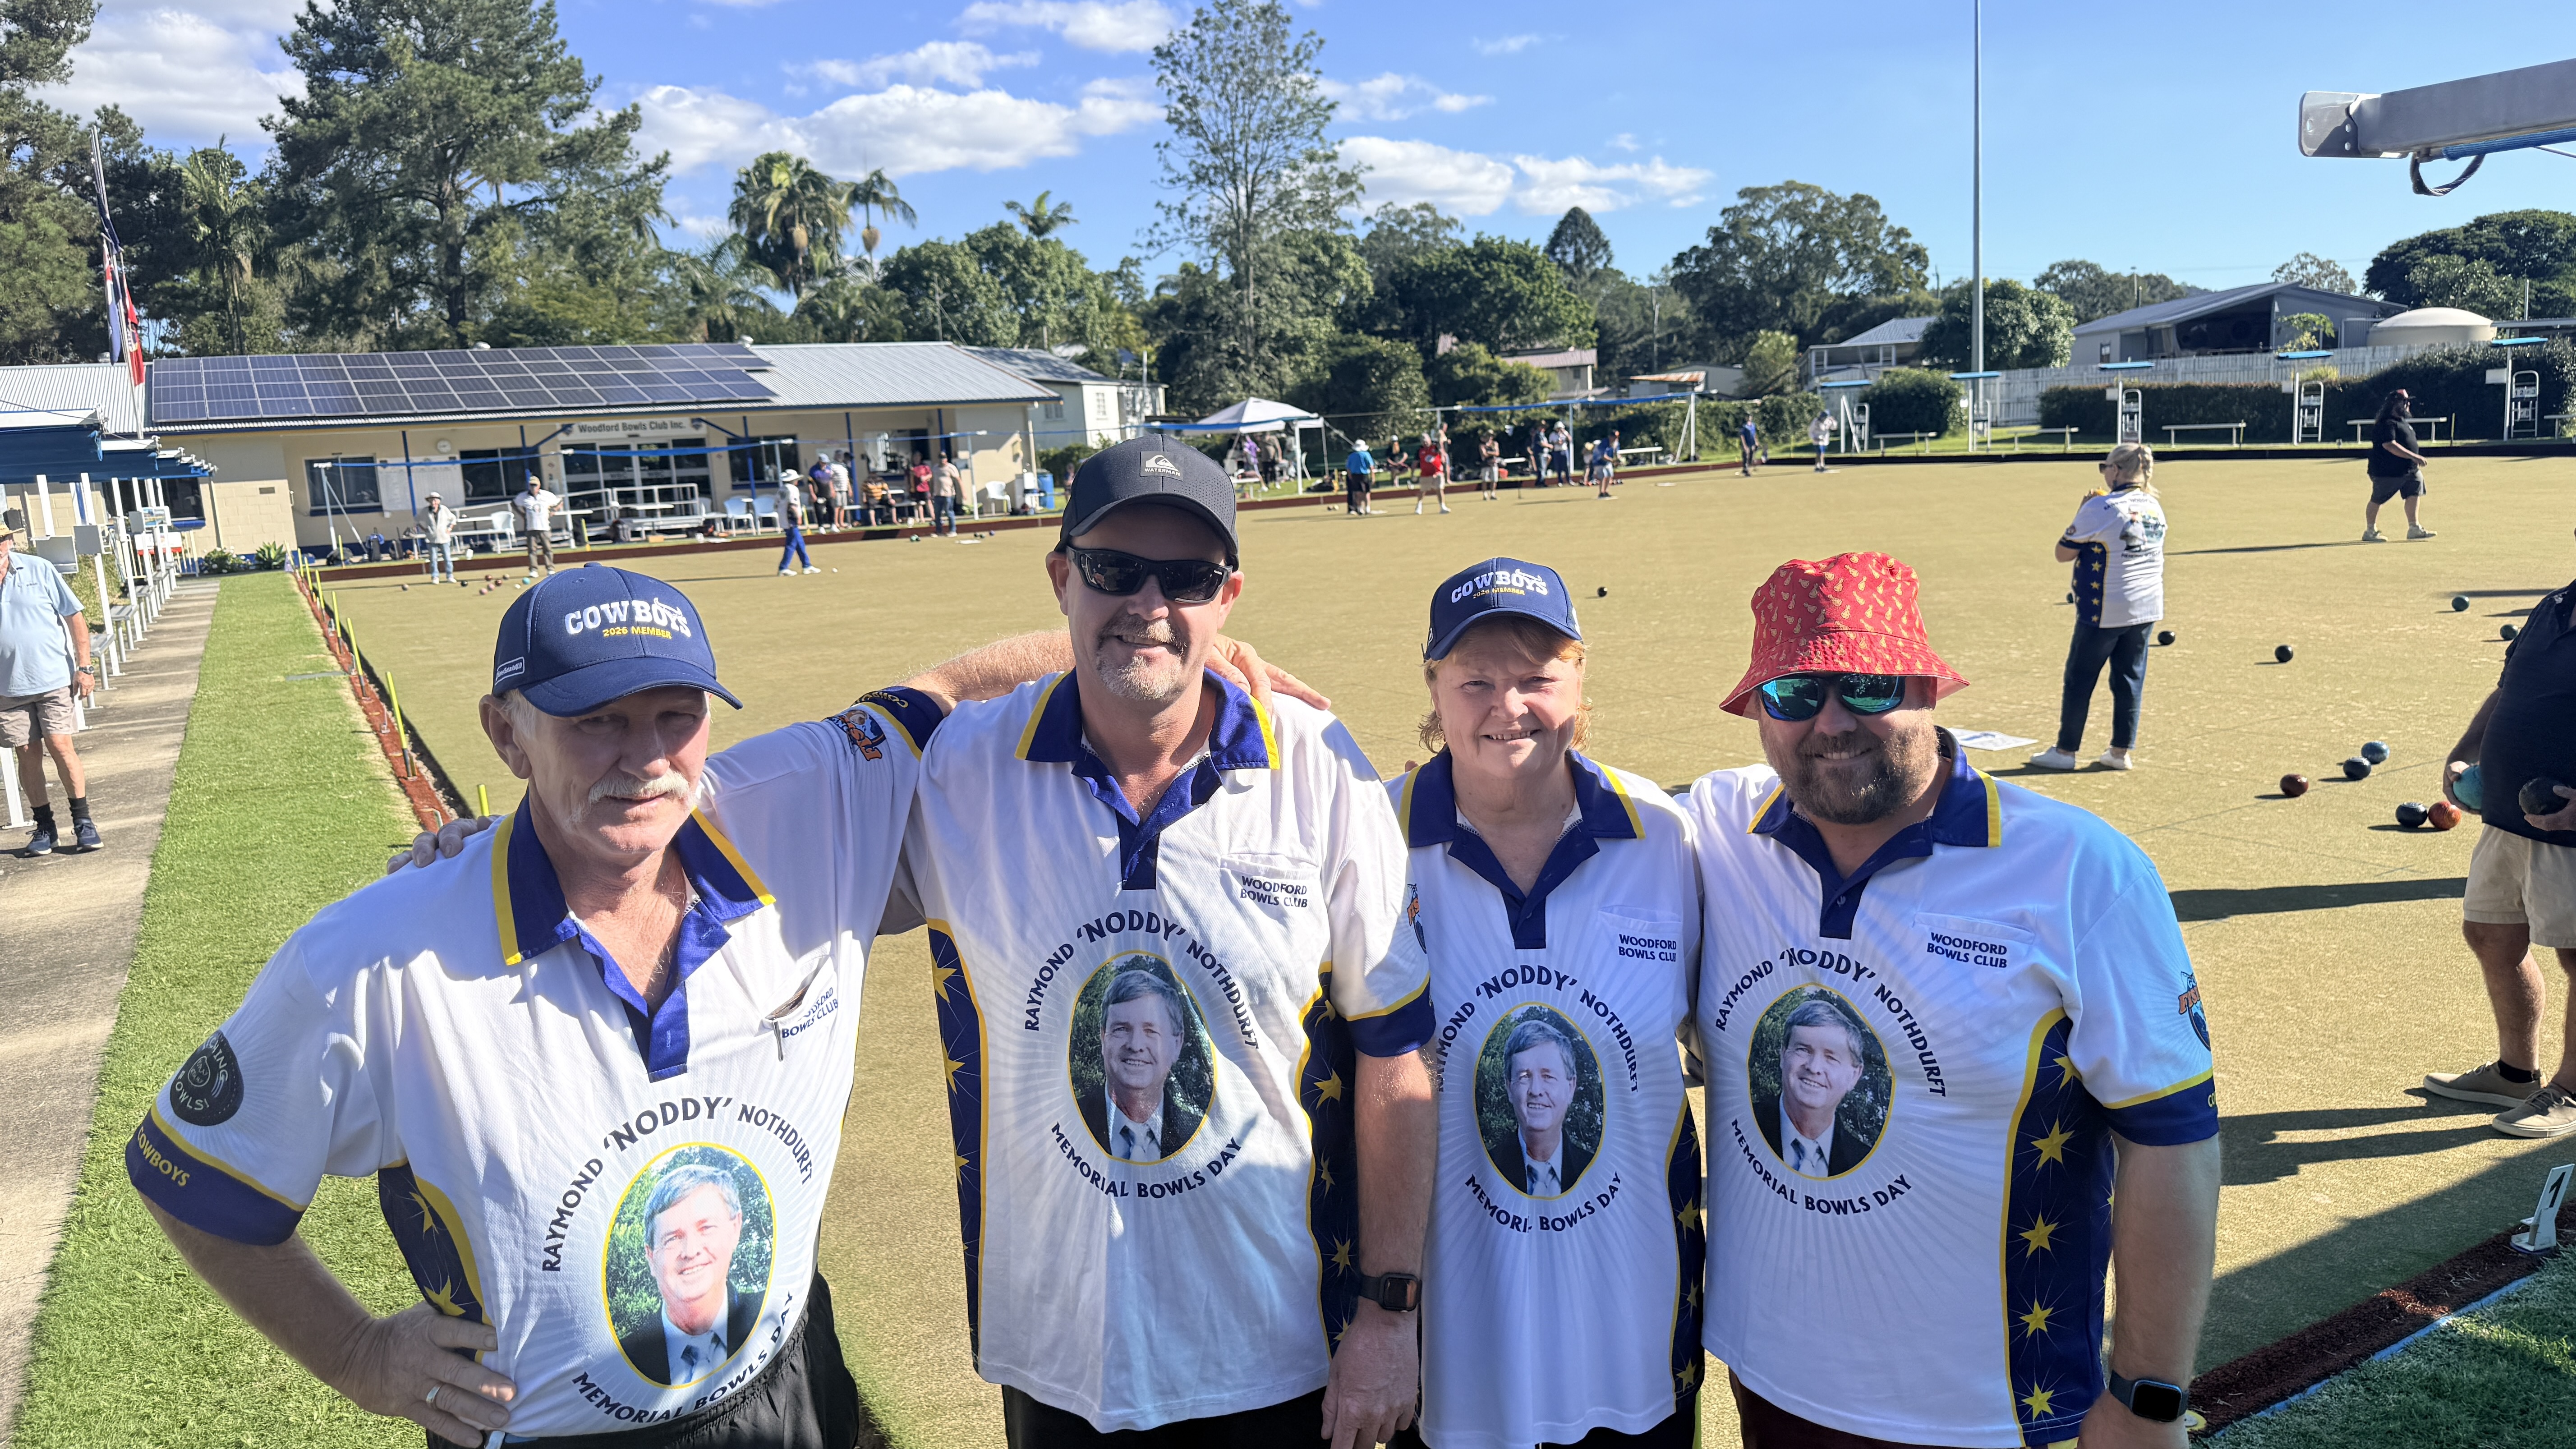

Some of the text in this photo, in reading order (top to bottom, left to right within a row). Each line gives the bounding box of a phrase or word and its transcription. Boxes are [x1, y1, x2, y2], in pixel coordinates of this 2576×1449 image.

[578, 420, 686, 433] Woodford Bowls Club Inc.
[1145, 468, 1180, 477] WATERMAN
[1451, 569, 1549, 603] COWBOYS
[565, 598, 691, 638] COWBOYS
[603, 626, 672, 639] 2026 MEMBER
[1240, 888, 1308, 908] BOWLS CLUB
[1242, 876, 1307, 895] WOODFORD
[1618, 946, 1656, 960] BOWLS
[1619, 934, 1677, 950] WOODFORD
[1927, 943, 2008, 969] BOWLS CLUB
[1931, 932, 2008, 956] WOODFORD
[1025, 943, 1075, 1031] RAYMOND
[1187, 939, 1260, 1049] NOTHDURFT
[782, 998, 838, 1038] BOWLS CLUB
[1716, 960, 1773, 1032] RAYMOND
[1874, 983, 1946, 1097] NOTHDURFT
[1580, 989, 1640, 1093] NOTHDURFT
[137, 1127, 190, 1187] COWBOYS
[1051, 1122, 1242, 1199] MEMORIAL BOWLS DAY
[1732, 1118, 1913, 1215] MEMORIAL BOWLS DAY
[542, 1158, 603, 1271] RAYMOND
[737, 1104, 814, 1185] NOTHDURFT
[1465, 1171, 1621, 1233] MEMORI BOWLS DAY
[2548, 1171, 2566, 1208] 1
[571, 1290, 793, 1423] MEMORIAL BOWLS DAY
